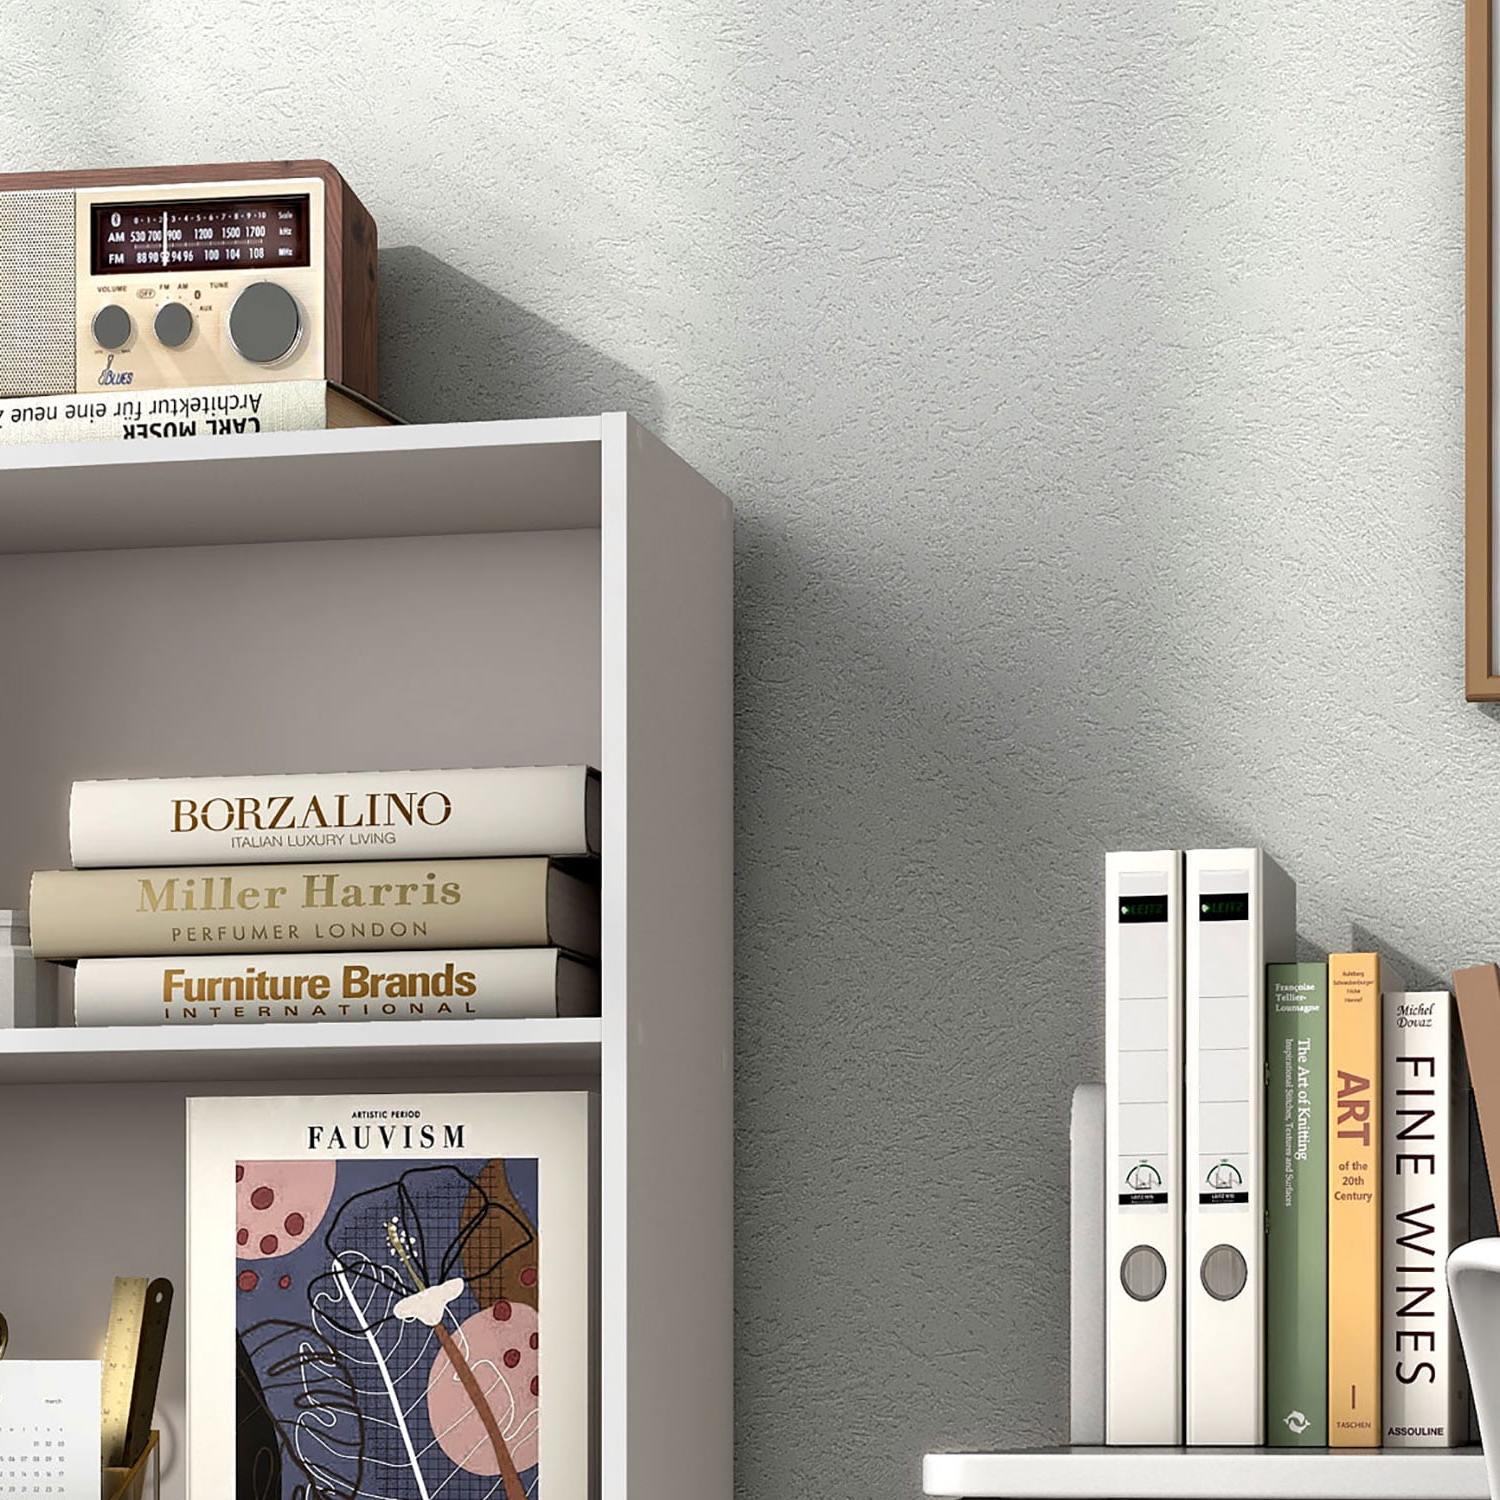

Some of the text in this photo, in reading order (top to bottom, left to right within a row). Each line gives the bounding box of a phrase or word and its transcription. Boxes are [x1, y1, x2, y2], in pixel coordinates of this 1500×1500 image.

[108, 226, 265, 243] AM 530 700 900 1200 1500 1700
[109, 248, 264, 264] FM 88 90 94 96 100 104 108
[12, 404, 57, 421] neue
[114, 400, 142, 420] für
[149, 393, 262, 416] Architektur
[66, 403, 107, 424] eine
[171, 791, 452, 833] BORZALINO
[231, 832, 396, 849] ITALIAN LUXURY LIVING
[136, 872, 462, 914] Miller Harris
[171, 922, 428, 942] PERFUMER LONDON
[163, 963, 477, 1003] Furniture Brands
[1275, 983, 1316, 992] Françoise
[164, 1002, 476, 1019] INTERNATIONAL
[1275, 1004, 1320, 1013] Loumagne
[1396, 1003, 1435, 1016] Michel
[1396, 1016, 1433, 1028] Dovaz
[1294, 1037, 1311, 1160] The Art of Knitting
[352, 1110, 421, 1119] ARTISTIC PERIOD
[1337, 1070, 1371, 1146] ART
[307, 1124, 466, 1149] FAUVISM
[1338, 1161, 1368, 1171] of the
[1342, 1176, 1364, 1186] 20th
[1334, 1191, 1372, 1203] Century
[1396, 1056, 1435, 1384] FINE WINES
[1336, 1421, 1371, 1429] TASCHEN
[1387, 1427, 1444, 1436] ASSOULINE
